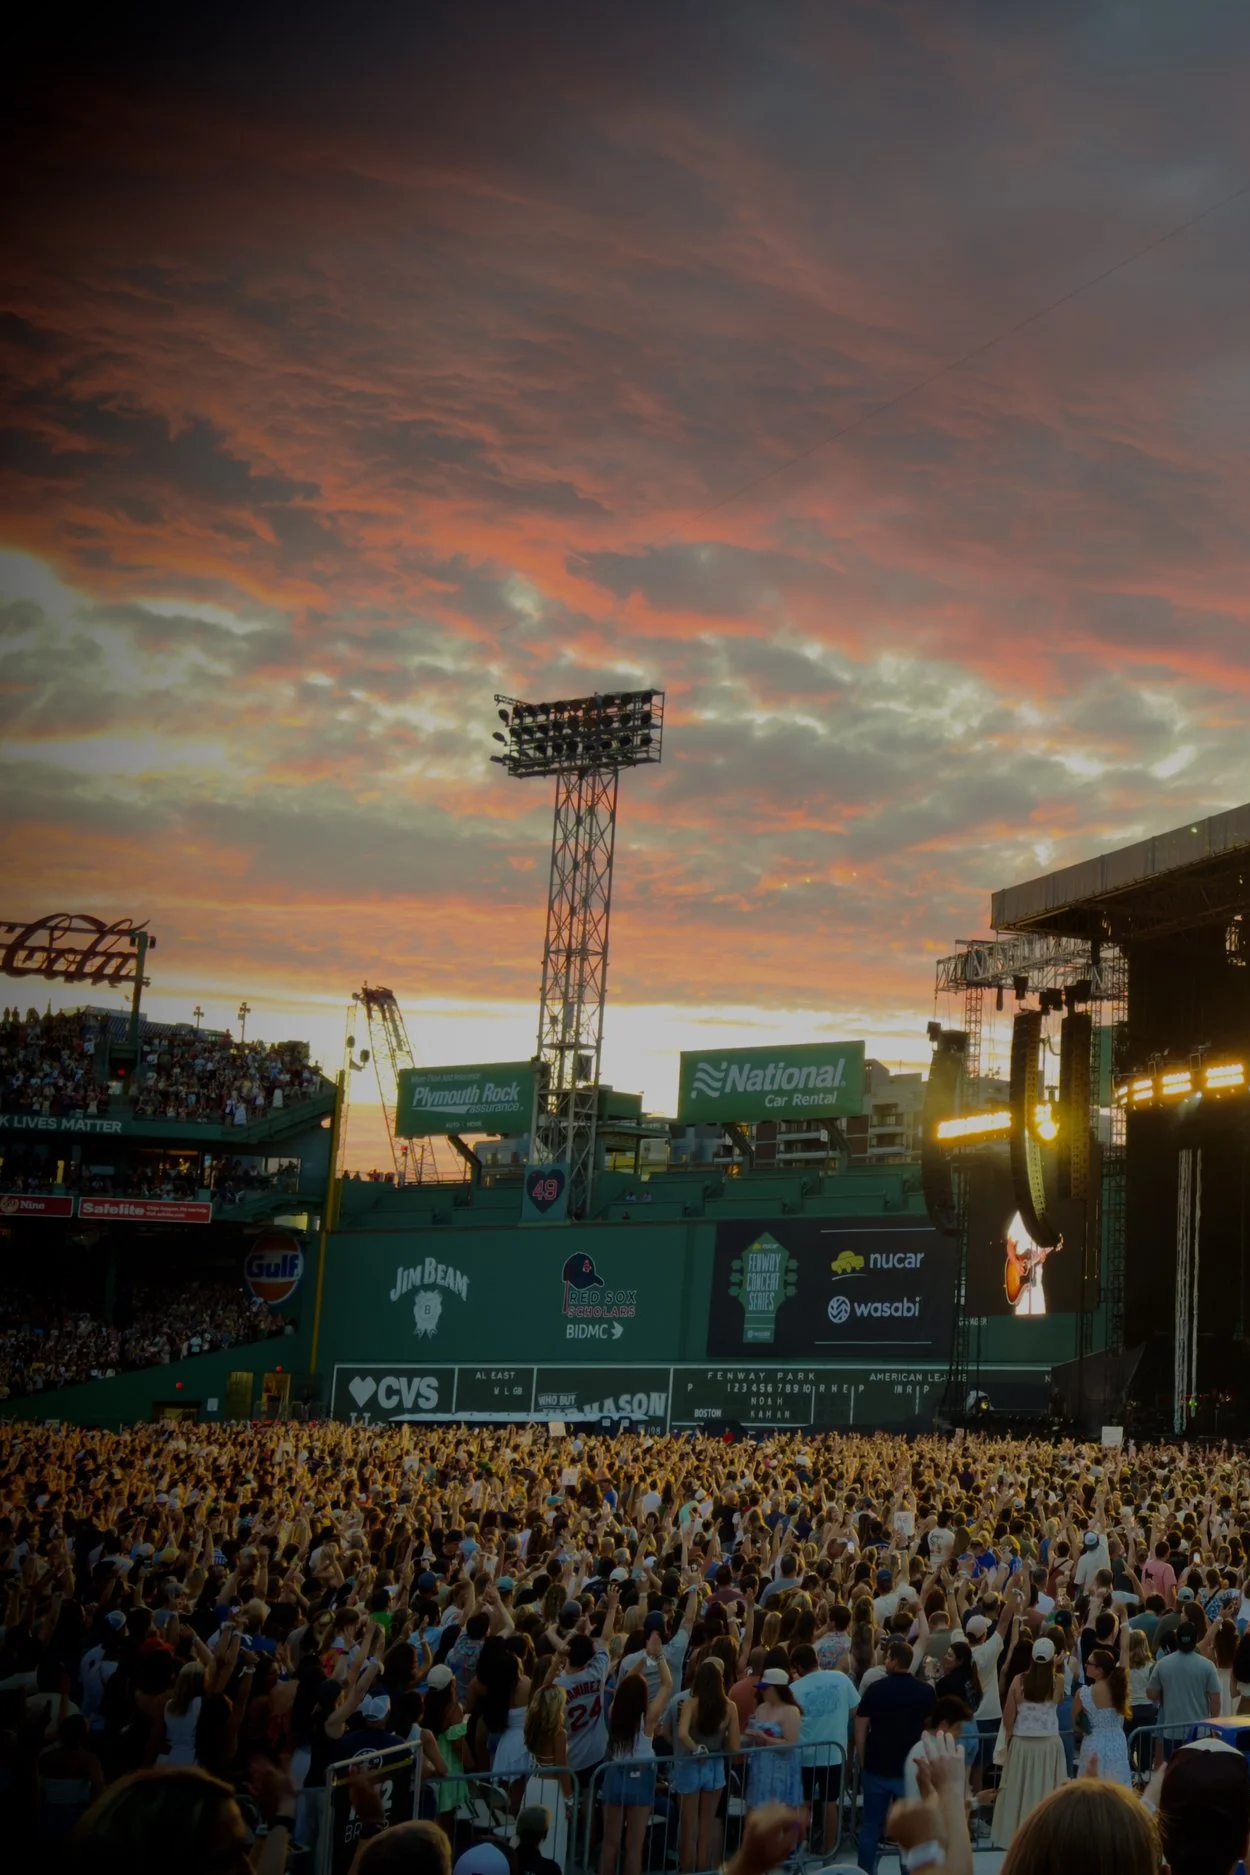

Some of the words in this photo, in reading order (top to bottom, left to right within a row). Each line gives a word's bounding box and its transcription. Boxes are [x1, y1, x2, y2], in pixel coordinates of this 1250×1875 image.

[725, 1058, 846, 1093] National
[412, 1084, 481, 1108] Plymouth
[483, 1081, 521, 1102] Rock
[765, 1094, 788, 1107] Car
[792, 1091, 838, 1106] Rental
[469, 1102, 520, 1113] assurance
[13, 1115, 58, 1130] LIVES
[61, 1117, 123, 1133] MATTER
[532, 1179, 558, 1200] 49
[82, 1202, 145, 1216] Safelite
[246, 1255, 299, 1277] Gulf
[748, 1252, 782, 1272] FENWAY
[869, 1252, 925, 1269] nucar
[390, 1265, 423, 1302] JIM
[423, 1257, 470, 1302] BEAM
[568, 1290, 601, 1305] RED
[605, 1290, 637, 1305] SOX
[748, 1292, 775, 1311] SERIES
[567, 1306, 636, 1318] SCHOLARS
[854, 1296, 921, 1317] wasabi
[566, 1324, 609, 1339] BIDMC
[475, 1371, 487, 1379] AL
[491, 1371, 516, 1379] EAST
[707, 1372, 766, 1380] FENWAY
[777, 1372, 816, 1381] PARK
[869, 1373, 922, 1382] AMERICAN
[377, 1376, 439, 1410] CVS
[687, 1384, 693, 1392] P
[727, 1384, 730, 1393] 1
[733, 1384, 739, 1393] 2
[741, 1384, 747, 1393] 3
[751, 1384, 757, 1393] 4
[759, 1384, 765, 1393] 5
[767, 1384, 773, 1393] 6
[778, 1384, 783, 1393] 7
[785, 1384, 791, 1393] 8
[793, 1384, 799, 1393] 9
[803, 1384, 812, 1393] 10
[819, 1384, 825, 1393] R
[832, 1384, 837, 1393] H
[843, 1384, 848, 1393] E
[859, 1385, 865, 1393] P
[537, 1395, 557, 1406] WHO
[559, 1394, 576, 1406] BUT
[751, 1397, 783, 1406] NOAH
[694, 1408, 722, 1418] BOSTON
[750, 1410, 790, 1419] KAHAN
[565, 1680, 602, 1704] AMIREZ
